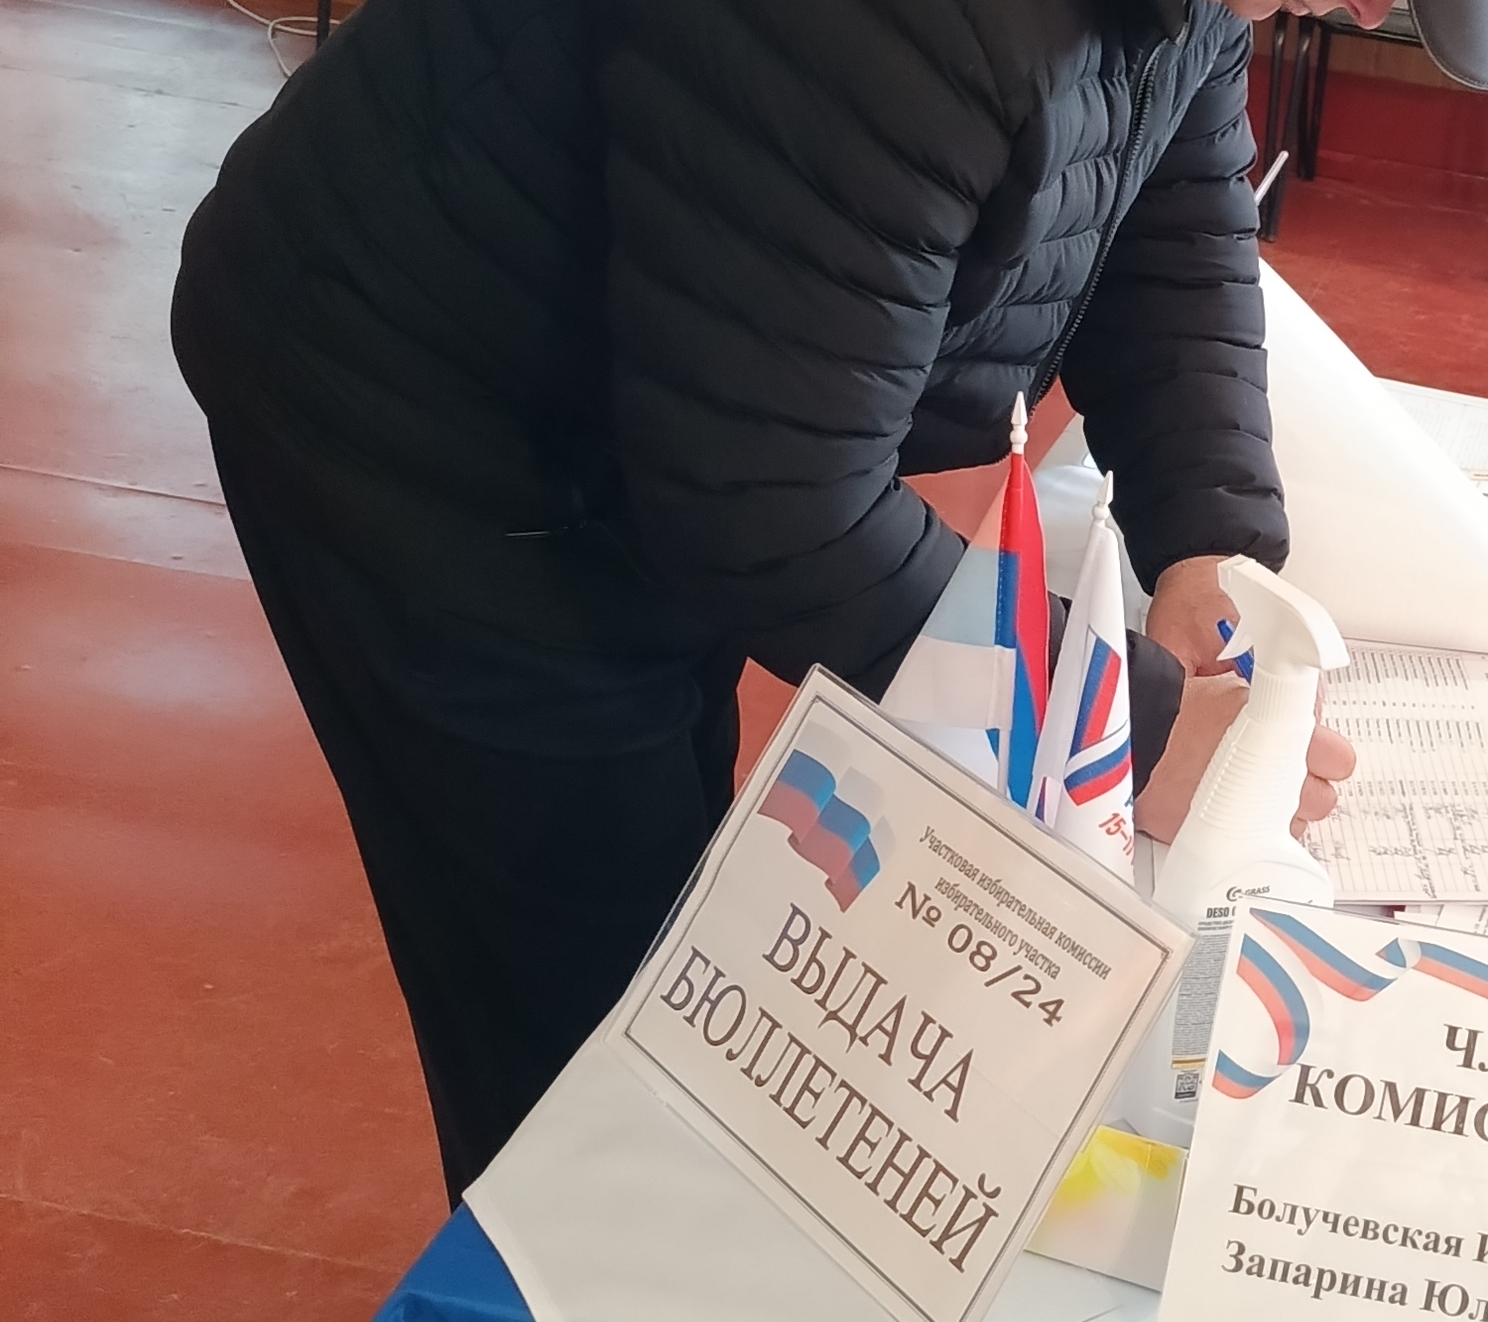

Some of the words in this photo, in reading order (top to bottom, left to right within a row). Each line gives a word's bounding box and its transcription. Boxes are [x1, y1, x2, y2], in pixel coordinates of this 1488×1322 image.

[919, 825, 978, 882] Участковая
[977, 873, 1057, 940] избирательная
[1054, 930, 1112, 980] комиссии
[935, 877, 1019, 947] избирательного
[1013, 938, 1061, 979] участка
[1206, 907, 1230, 918] DESO
[1244, 885, 1271, 896] GRASS
[895, 879, 942, 929] №
[947, 923, 1066, 1027] 08/24
[761, 902, 979, 1123] ВЫДАЧА
[661, 946, 1001, 1274] БЮЛЛЕТЕНЕЙ
[1221, 1238, 1409, 1306] Запарина
[1227, 1183, 1464, 1261] Болучевская
